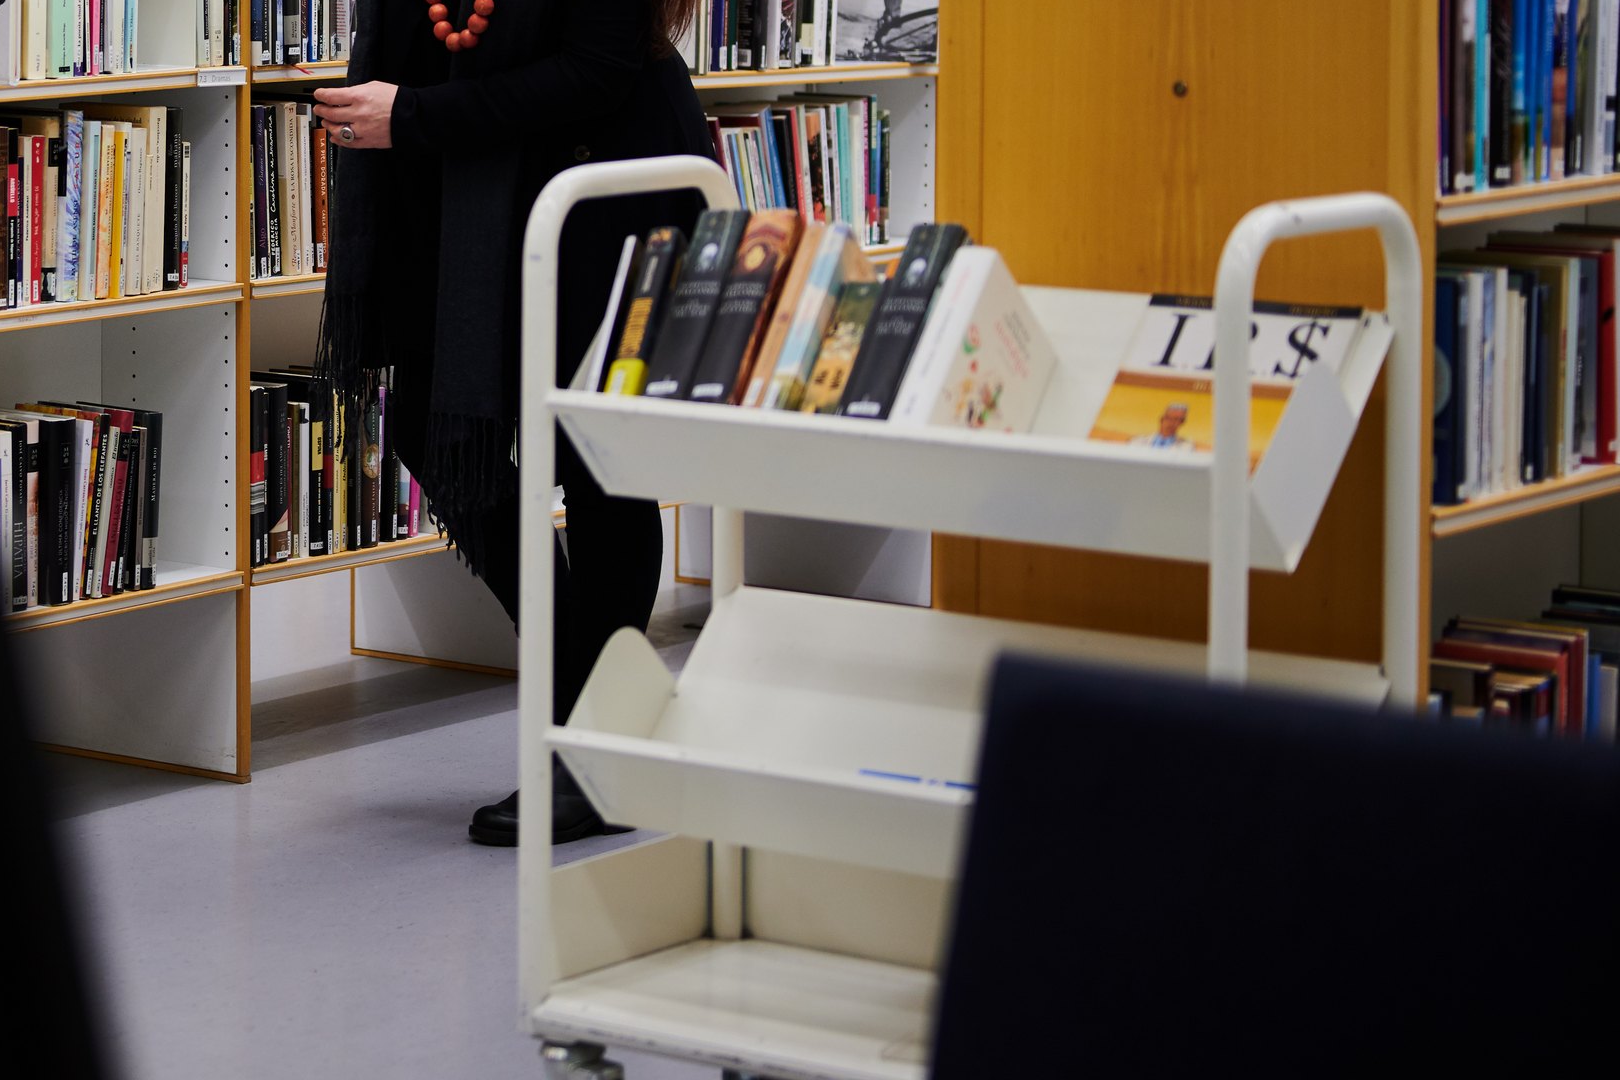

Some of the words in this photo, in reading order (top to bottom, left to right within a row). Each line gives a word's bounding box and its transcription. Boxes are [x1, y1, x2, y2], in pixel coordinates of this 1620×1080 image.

[198, 74, 207, 83] 7.3
[211, 73, 231, 83] Dramas
[99, 433, 108, 469] ELEFANTES
[14, 521, 23, 579] HIPATIA
